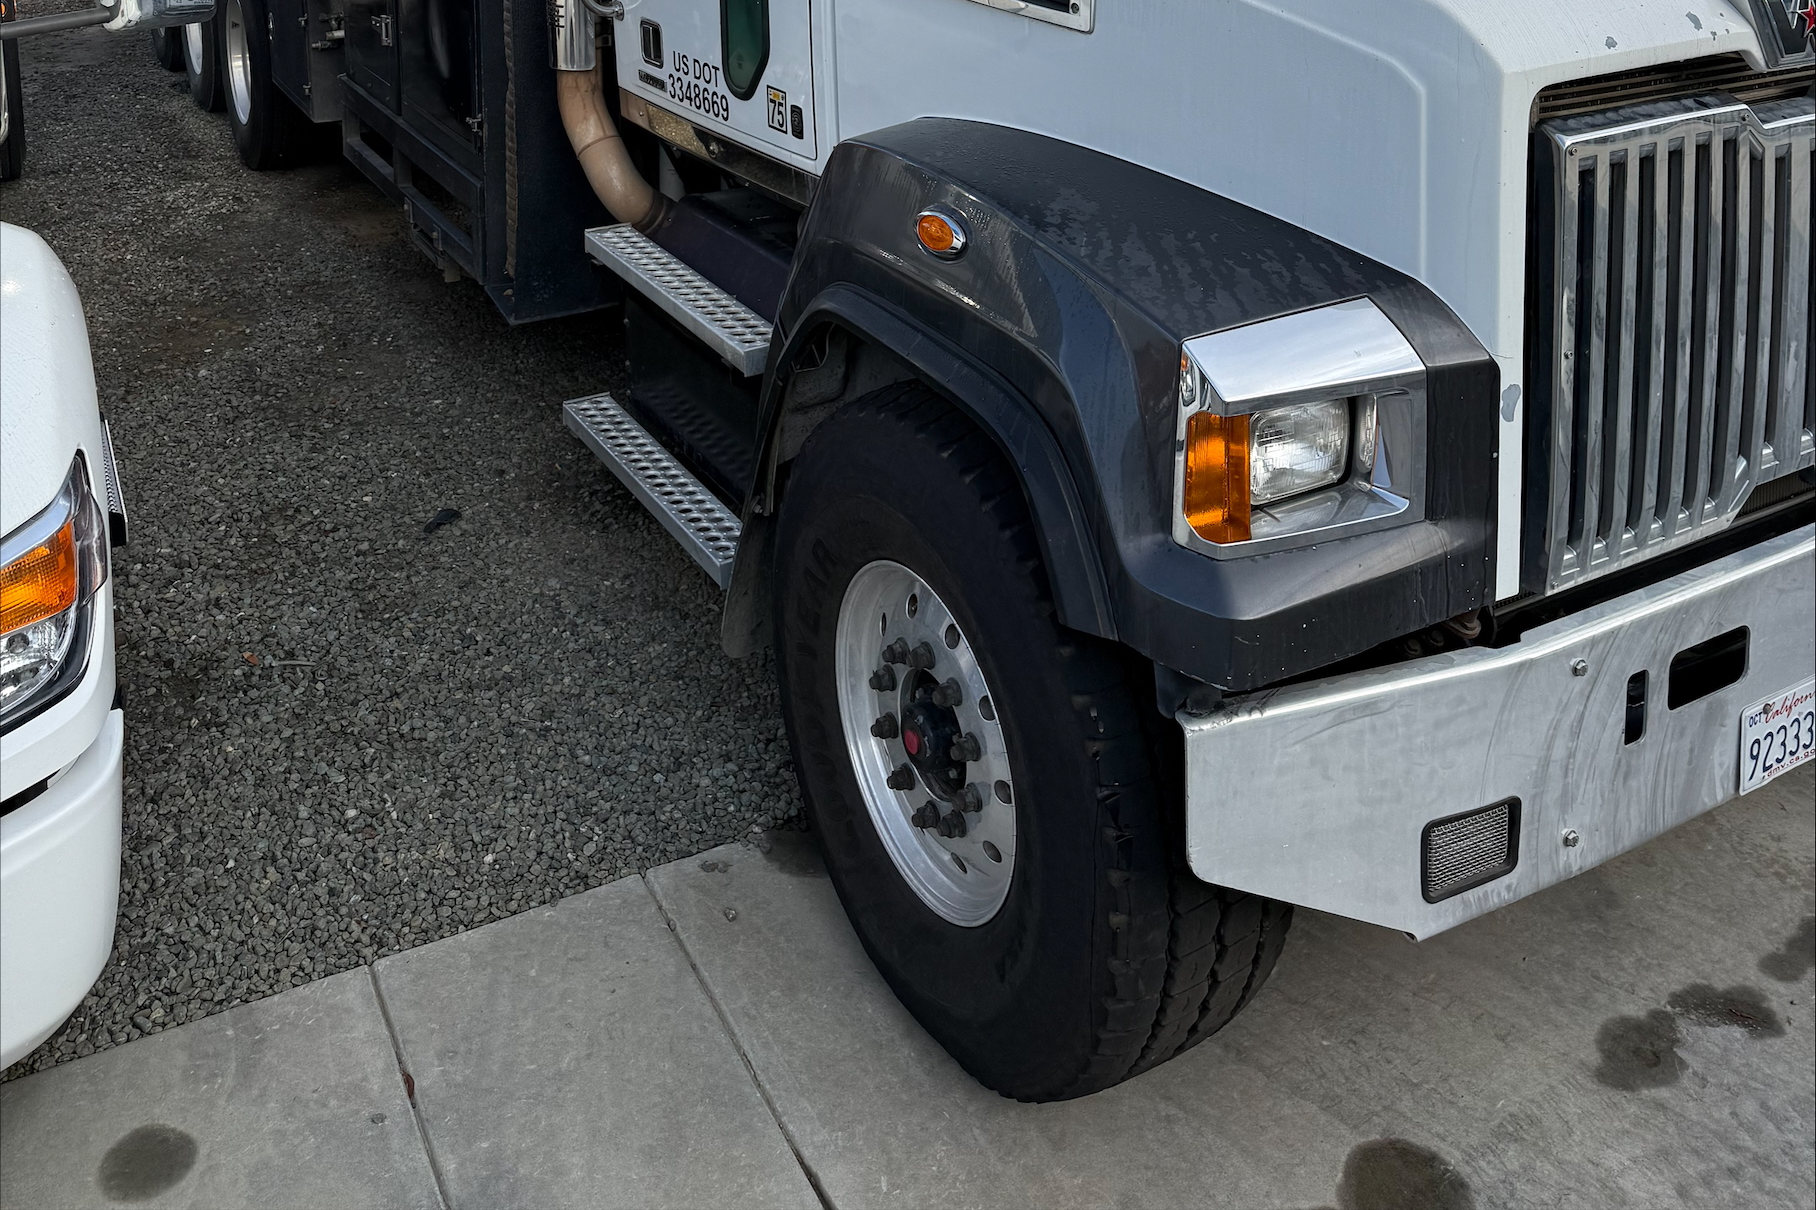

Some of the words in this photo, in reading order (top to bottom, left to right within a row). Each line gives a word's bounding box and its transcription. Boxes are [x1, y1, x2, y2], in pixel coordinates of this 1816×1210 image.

[673, 50, 689, 75] US
[693, 58, 720, 88] DOT
[668, 73, 729, 122] 3348669
[769, 98, 785, 128] 75
[1748, 711, 1763, 728] OCT
[1749, 711, 1815, 781] 92333
